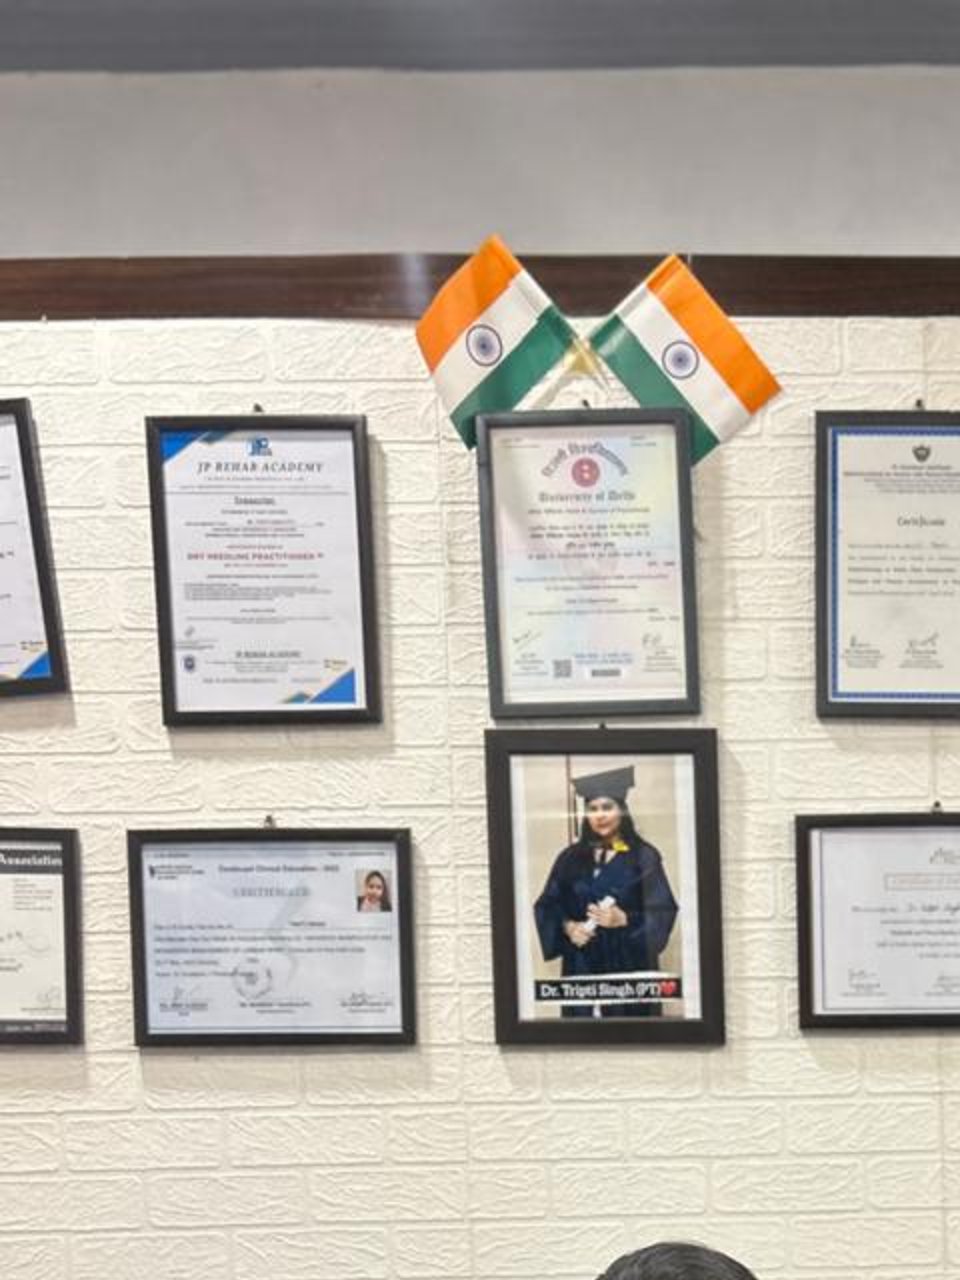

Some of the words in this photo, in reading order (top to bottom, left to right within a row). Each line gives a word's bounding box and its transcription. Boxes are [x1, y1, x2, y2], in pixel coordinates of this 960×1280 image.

[197, 462, 211, 474] JP
[215, 462, 258, 472] REHAB
[262, 462, 325, 472] ACADEMY
[541, 983, 560, 997] Dr.
[562, 982, 597, 999] Tripti
[599, 981, 634, 999] Singh
[636, 981, 661, 997] (PT)
